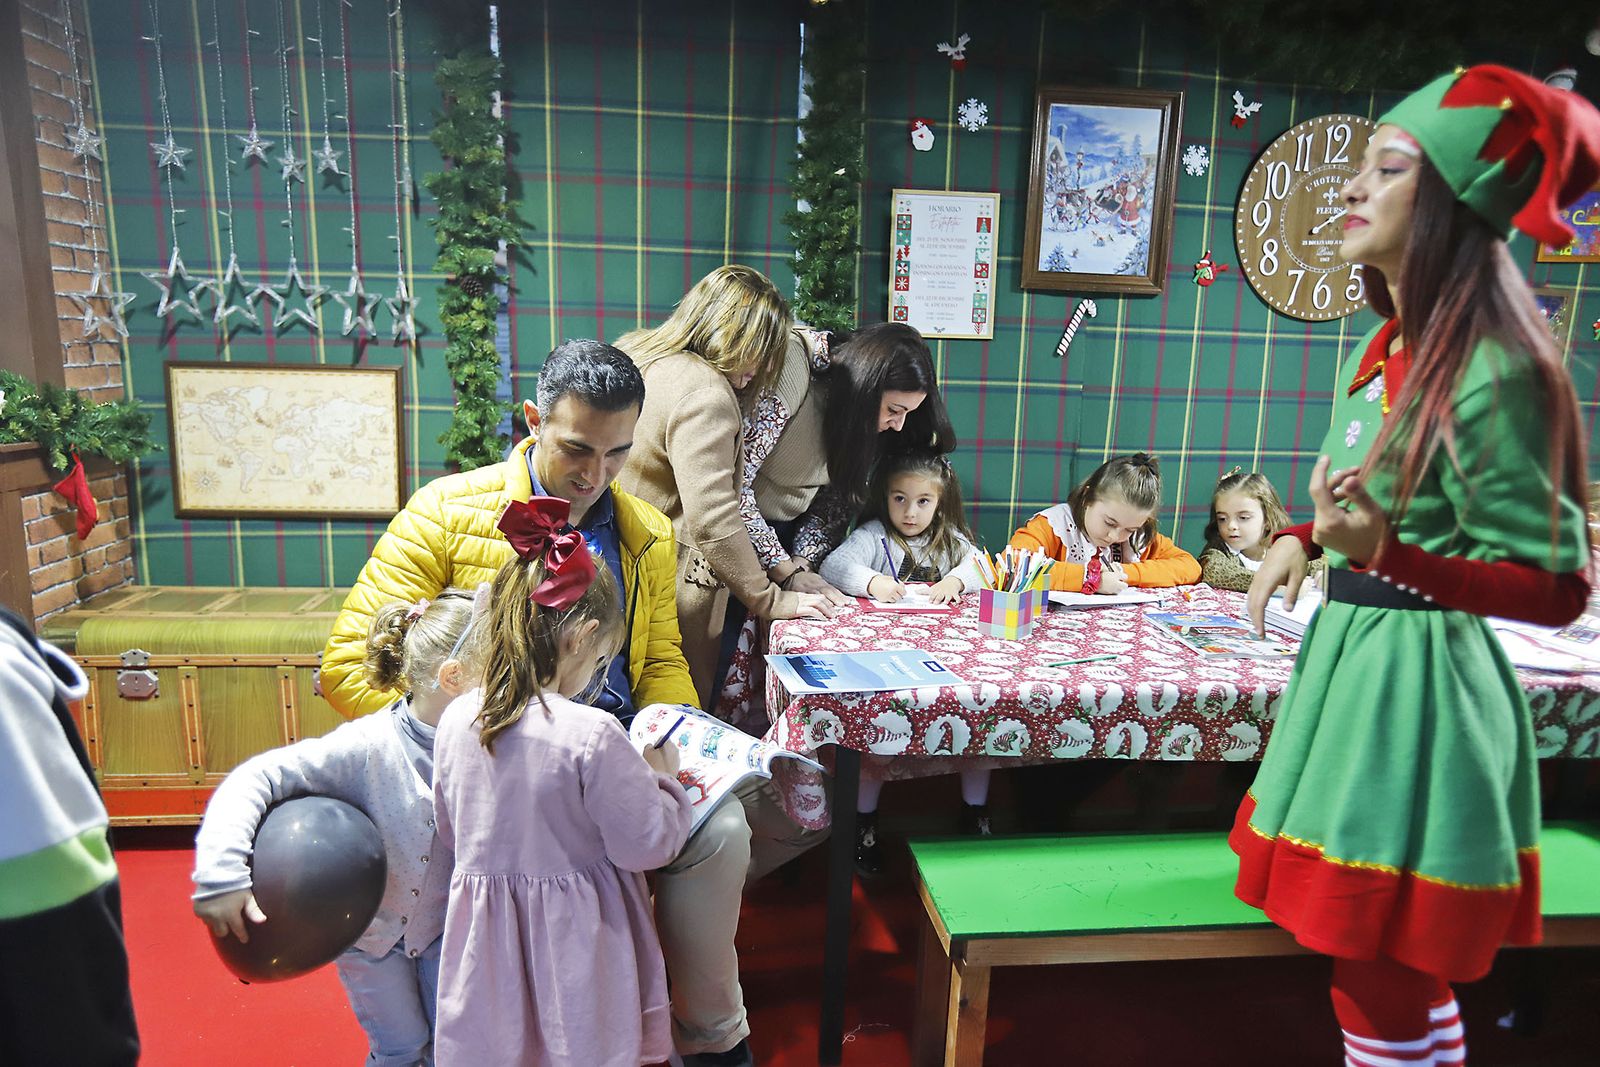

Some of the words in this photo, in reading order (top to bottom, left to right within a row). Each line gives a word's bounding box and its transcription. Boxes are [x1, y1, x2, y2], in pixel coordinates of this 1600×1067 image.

[1294, 133, 1314, 172] 11
[1323, 123, 1352, 163] 12
[1264, 161, 1291, 200] 10
[928, 204, 962, 213] HORARIO
[1252, 200, 1272, 239] 9
[1259, 238, 1279, 276] 8
[1287, 269, 1306, 307] 7
[1312, 272, 1332, 310] 6
[1345, 264, 1365, 301] 5
